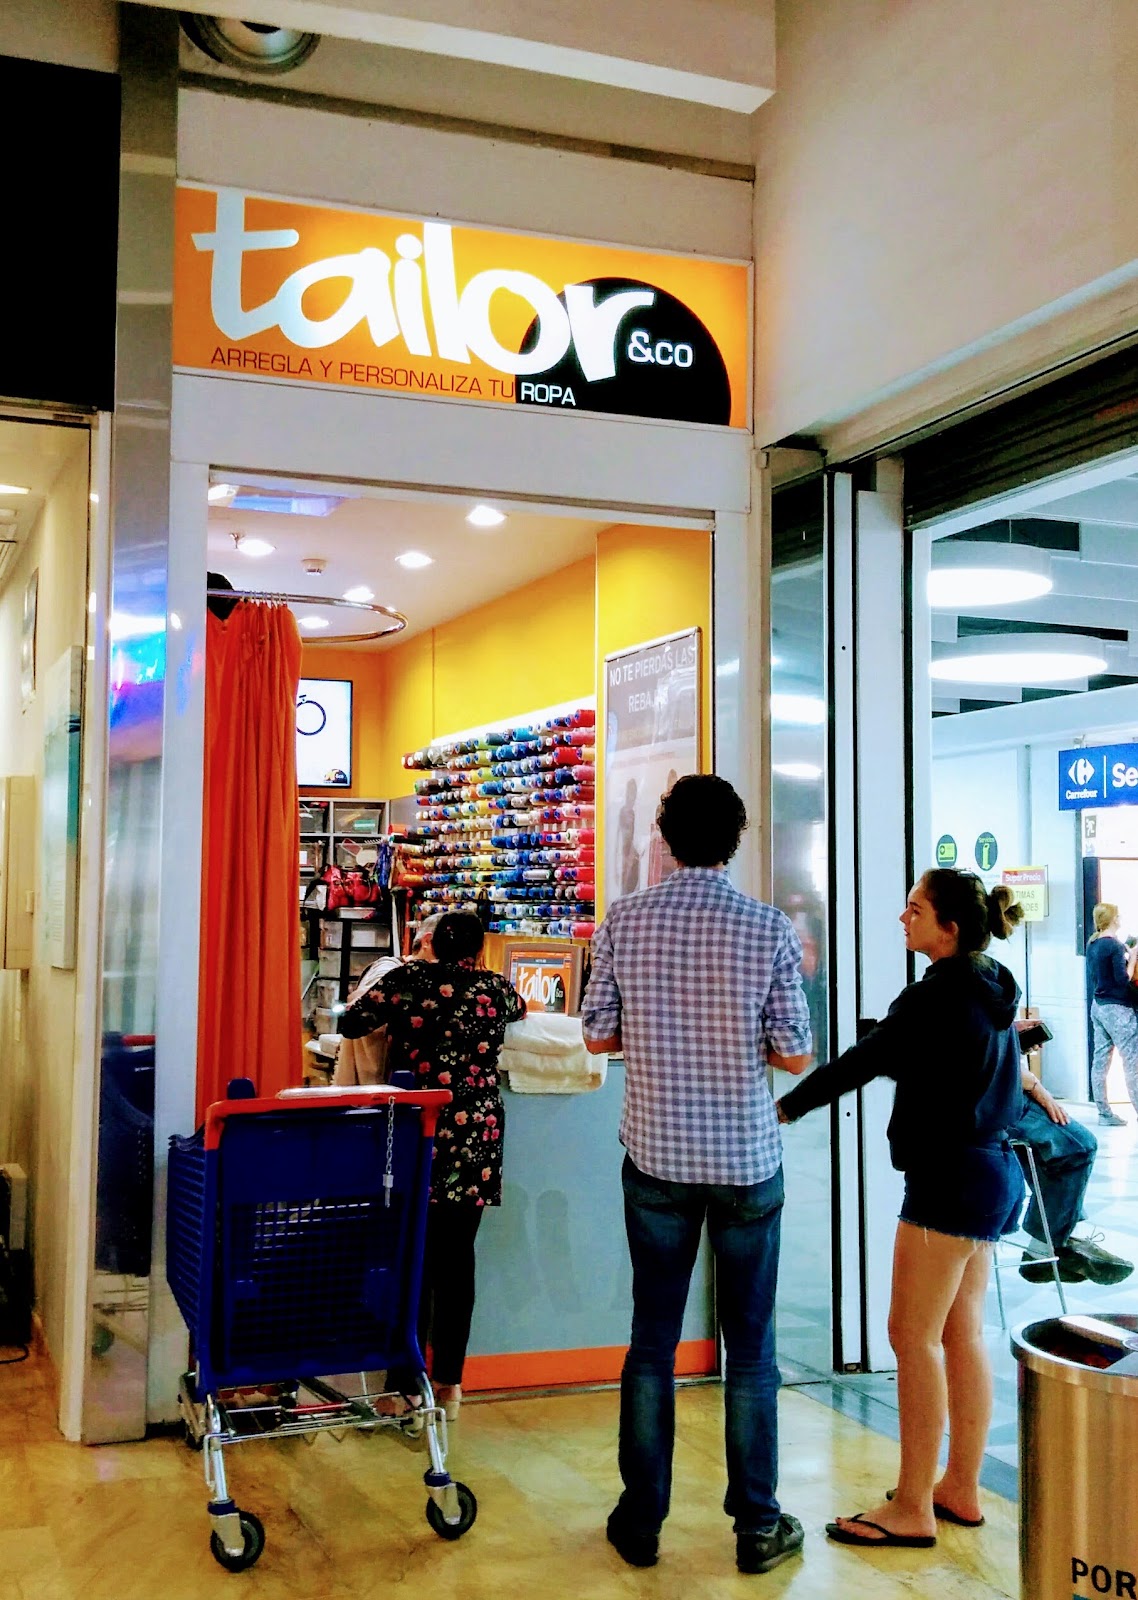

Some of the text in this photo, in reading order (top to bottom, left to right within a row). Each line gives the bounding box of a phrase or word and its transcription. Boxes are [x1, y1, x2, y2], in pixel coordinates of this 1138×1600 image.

[191, 188, 654, 382] tailor
[211, 346, 577, 406] ARREGLA Y PERSONALIZA TU ROPA
[609, 645, 694, 687] NO TE PIERDAS LAS
[1066, 788, 1098, 800] Carrefour
[1005, 874, 1022, 883] Super
[1015, 890, 1035, 899] TIMAS
[519, 966, 560, 1005] tailor
[1071, 1556, 1138, 1600] POR
